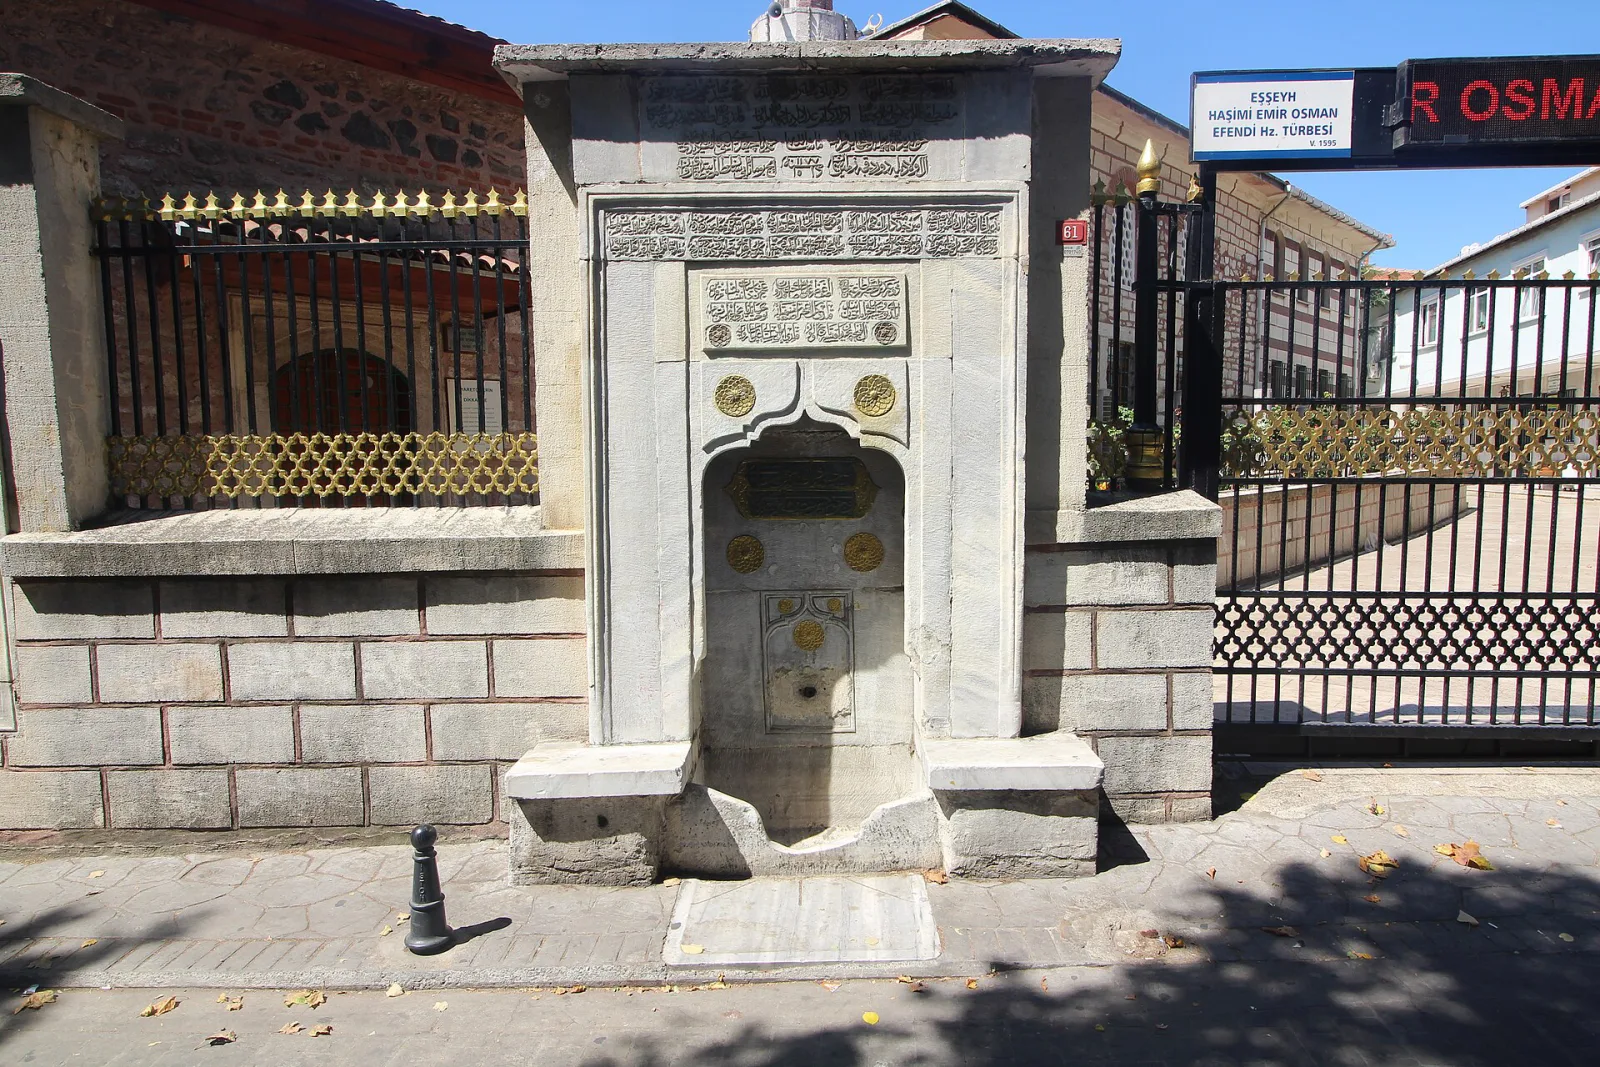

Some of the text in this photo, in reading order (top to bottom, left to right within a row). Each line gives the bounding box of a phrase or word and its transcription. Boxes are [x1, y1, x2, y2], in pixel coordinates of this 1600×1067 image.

[1250, 91, 1297, 106] EŞŞEYH
[1208, 106, 1338, 123] HAŞİMİ EMİR OSMAN
[1212, 122, 1333, 138] EFENDİ Hz. TÜRBESİ
[1319, 139, 1337, 147] 1595
[1063, 225, 1078, 239] 61
